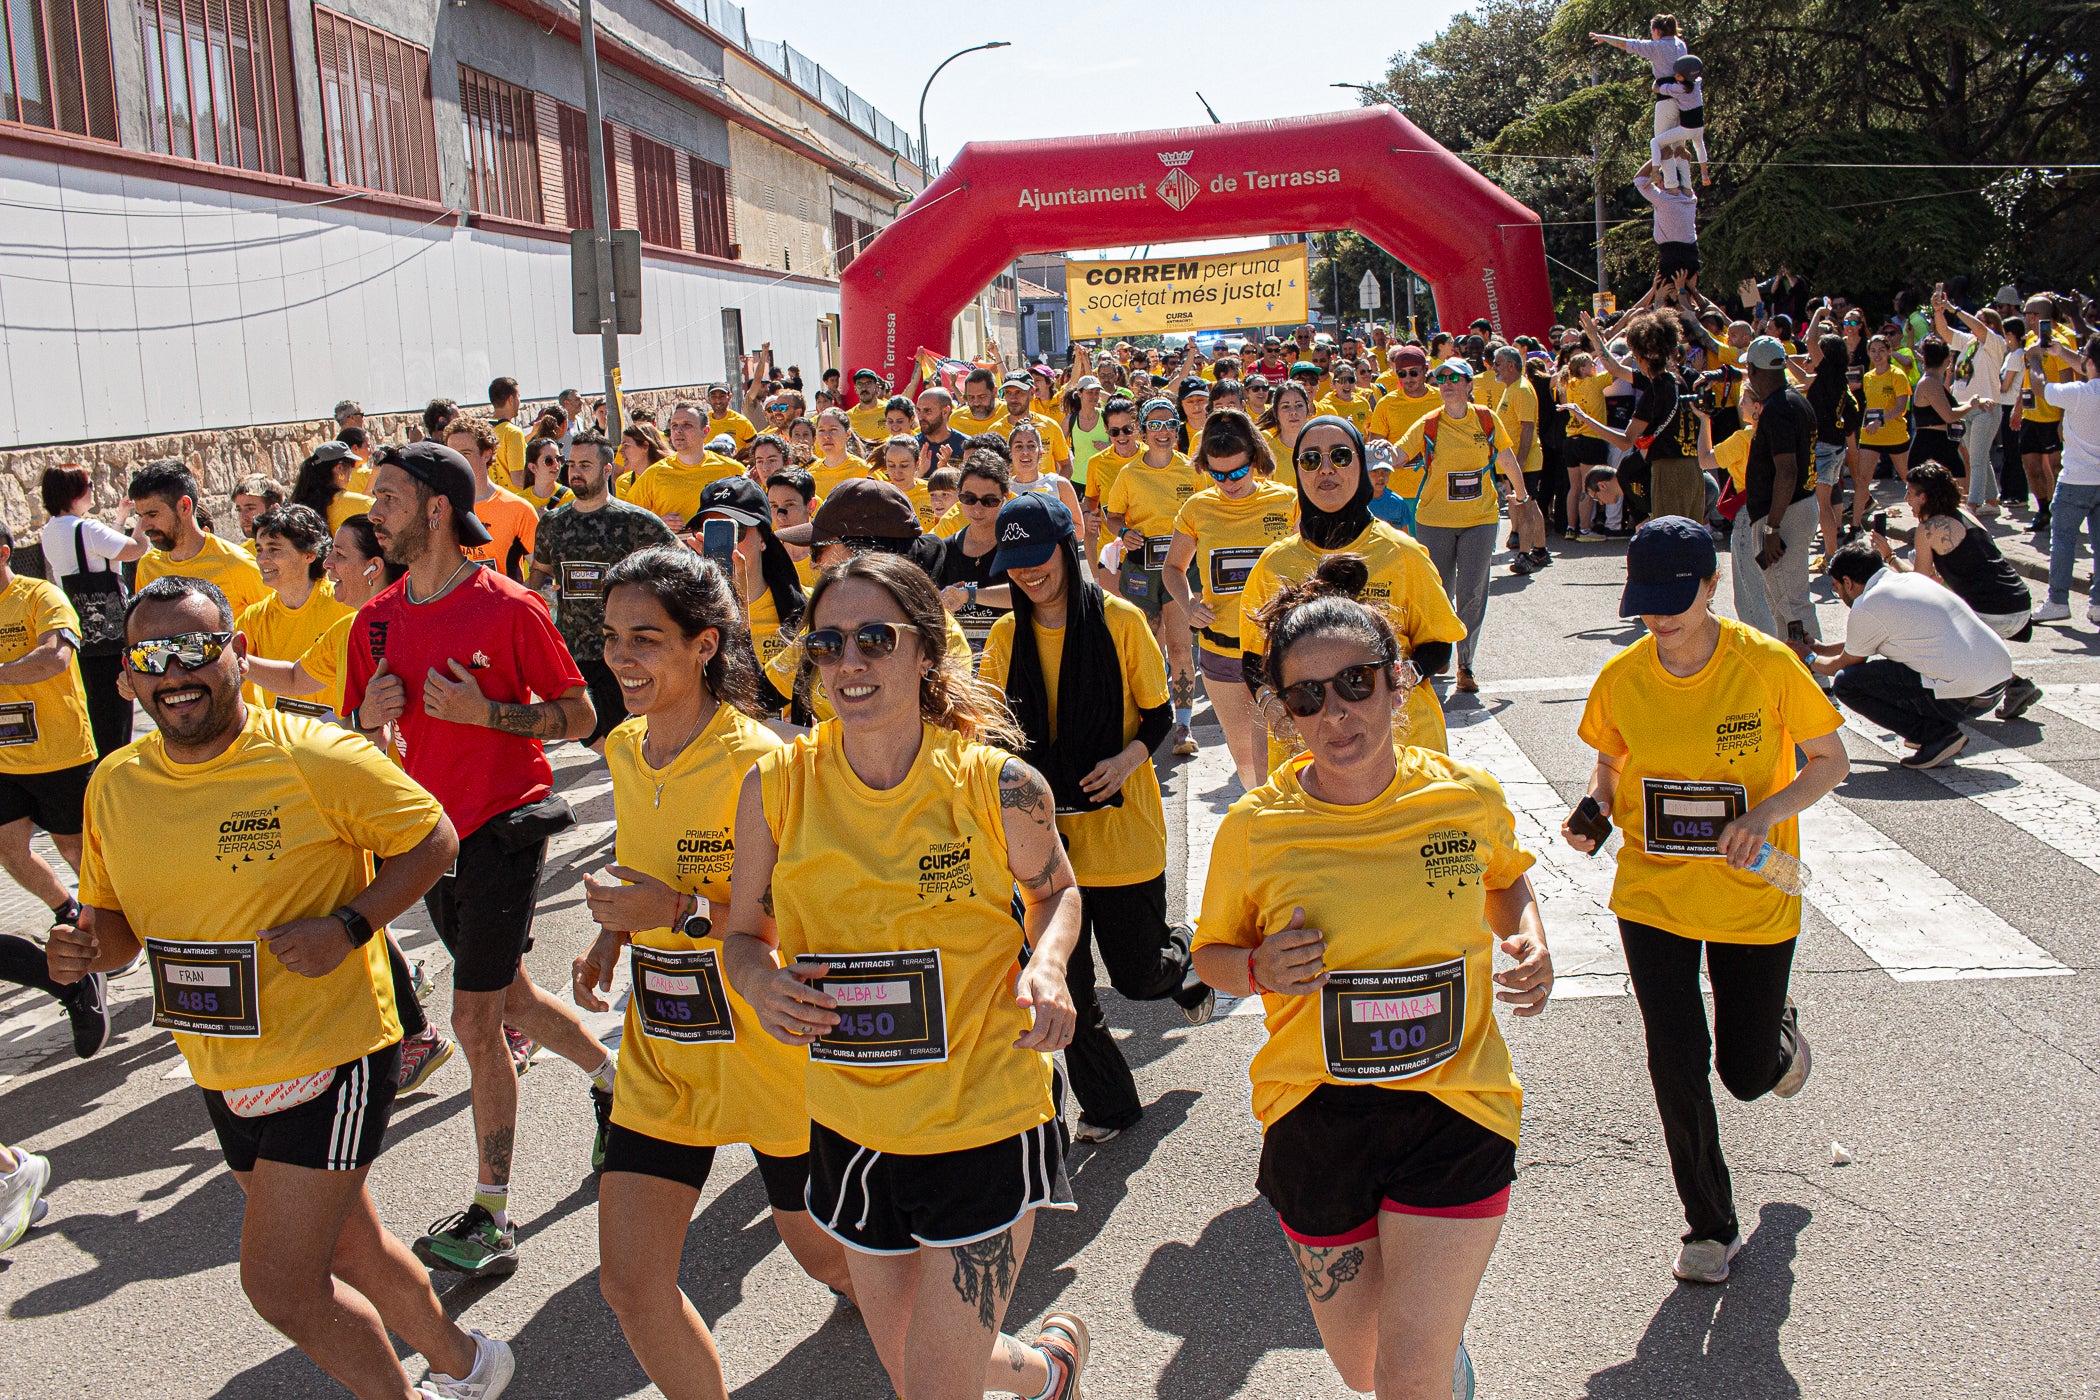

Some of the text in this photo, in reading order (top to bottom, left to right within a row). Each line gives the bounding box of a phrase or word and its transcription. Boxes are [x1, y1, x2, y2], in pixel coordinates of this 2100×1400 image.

[1018, 168, 1341, 211] Ajuntament de Terrassa
[1086, 258, 1280, 286] CORREM per una
[1087, 279, 1282, 310] societat més justa!
[1166, 312, 1193, 320] CURSA
[884, 313, 896, 369] Terrassa
[1725, 712, 1759, 723] PRIMERA
[1716, 718, 1762, 735] CURSA
[1716, 735, 1762, 751] TERRASSA
[231, 809, 273, 819] PRIMERA
[219, 817, 281, 833] CURSA
[1673, 820, 1713, 837] 045
[218, 831, 282, 843] ANTIRACISTA
[685, 830, 724, 838] PRIMERA
[217, 840, 282, 854] TERRASSA
[677, 839, 735, 853] CURSA
[930, 842, 965, 853] PRIMERA
[1420, 839, 1477, 858] CURSA
[919, 848, 970, 871] CURSA
[1425, 863, 1482, 879] TERRASSA
[163, 946, 181, 954] CURSA
[902, 957, 935, 966] TERRASSA
[179, 970, 205, 982] FRAN
[1352, 977, 1380, 985] CURSA
[1434, 965, 1462, 979] TERRASSA
[178, 990, 219, 1012] 485
[837, 985, 872, 1002] ALBA
[656, 999, 691, 1020] 435
[1355, 996, 1437, 1023] TAMARA
[839, 1012, 895, 1037] 450
[1370, 1025, 1427, 1052] 100
[833, 1049, 855, 1058] CURSA
[909, 1047, 941, 1055] TERRASSA
[1331, 1066, 1356, 1074] PRIMERA
[1357, 1065, 1387, 1074] CURSA
[1435, 1045, 1458, 1060] TERRASSA
[284, 1078, 301, 1096] LOLA
[249, 1090, 265, 1106] LOLA
